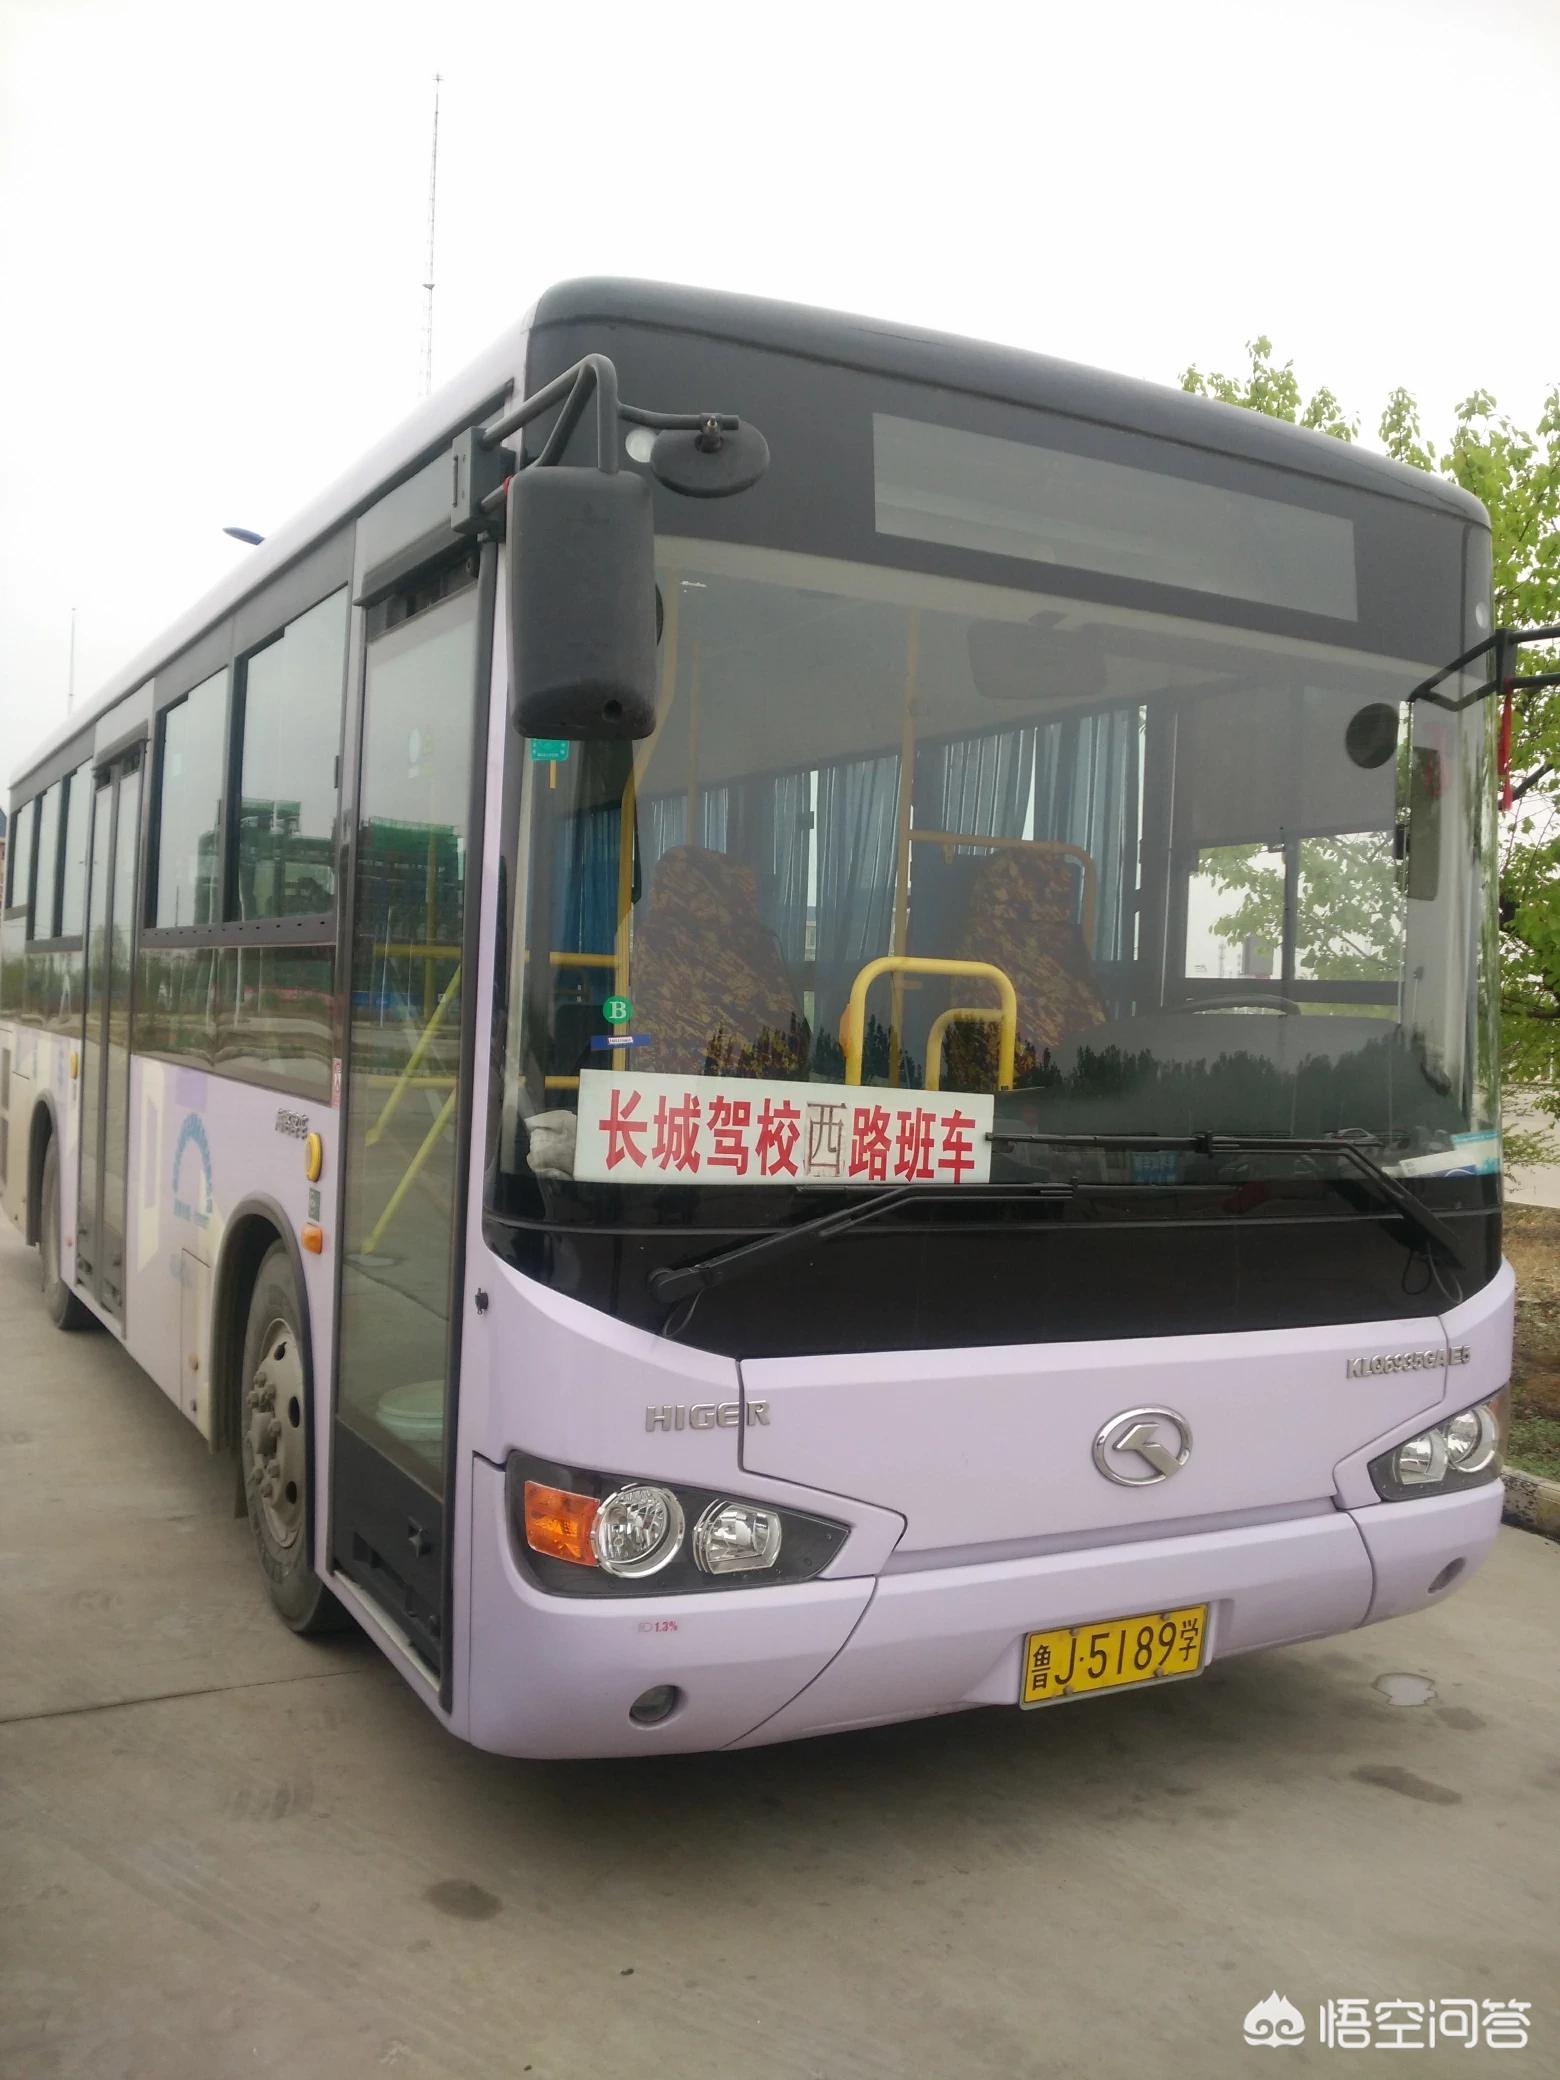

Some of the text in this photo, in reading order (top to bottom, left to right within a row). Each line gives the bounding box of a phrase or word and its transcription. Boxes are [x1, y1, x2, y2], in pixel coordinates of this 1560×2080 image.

[609, 1001, 627, 1019] B
[598, 1088, 977, 1184] 长城驾校西路班车
[645, 1400, 770, 1432] HIGER
